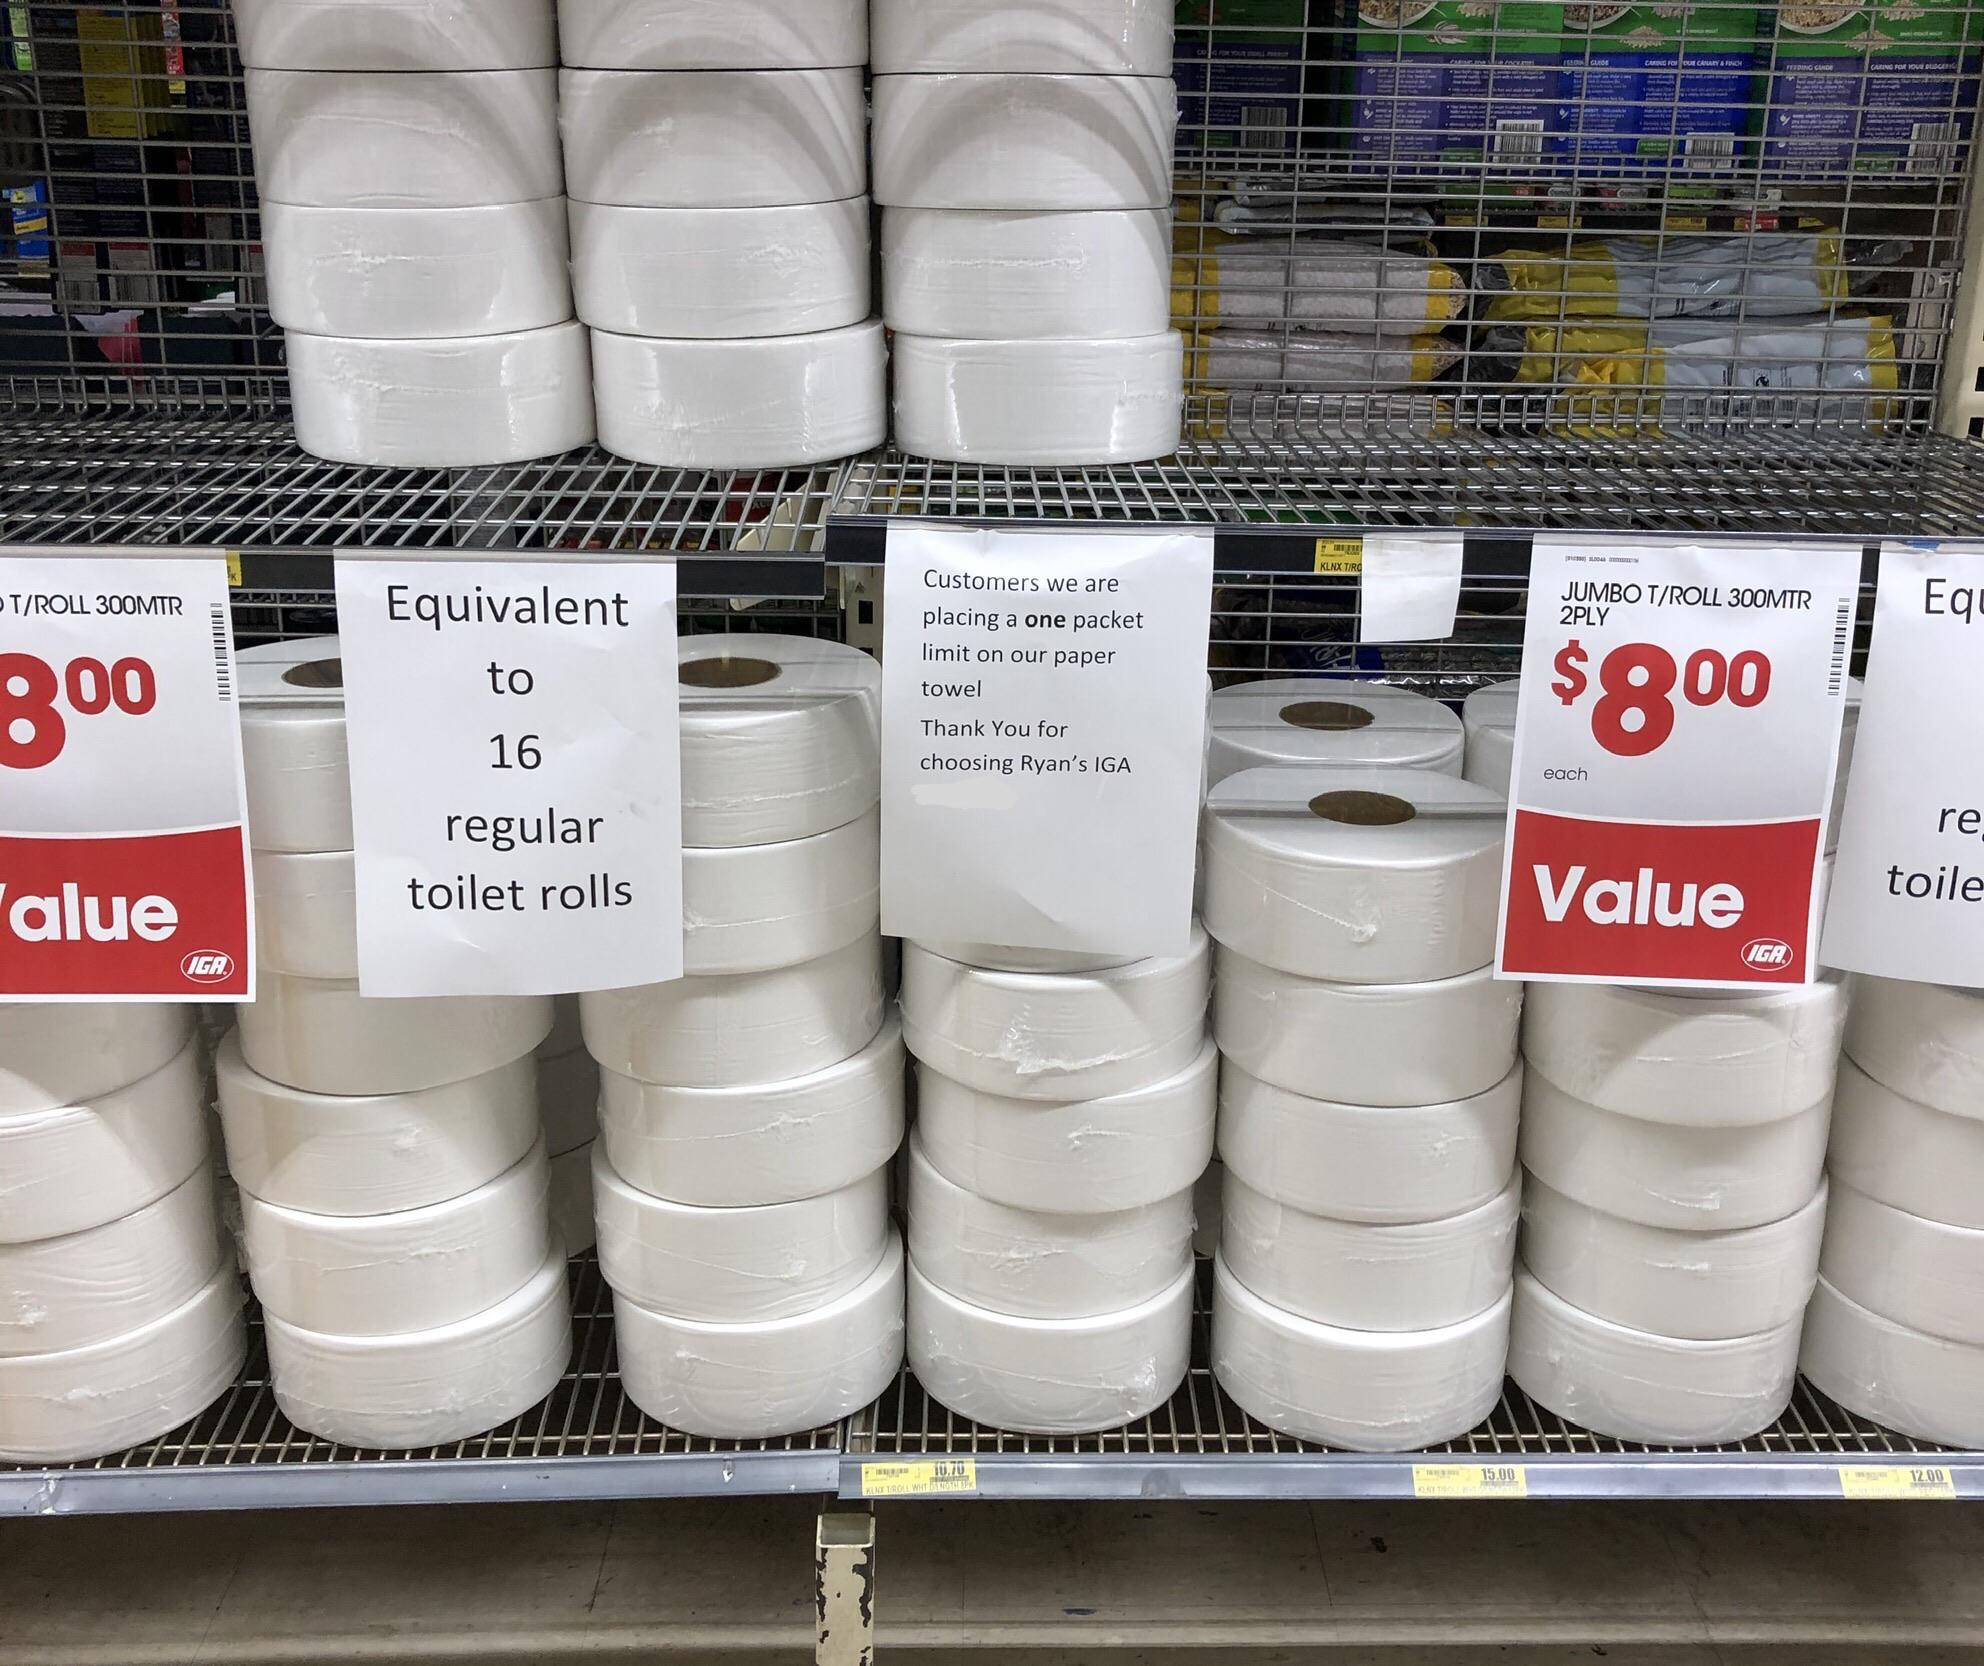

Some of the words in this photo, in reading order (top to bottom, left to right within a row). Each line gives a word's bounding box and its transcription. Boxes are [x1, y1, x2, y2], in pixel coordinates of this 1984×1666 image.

[1320, 561, 1342, 572] KLNX
[923, 569, 1040, 592] Customers
[1046, 578, 1078, 593] we
[1085, 578, 1119, 593] are
[9, 594, 91, 617] T/ROLL
[96, 594, 183, 616] 300MTR
[1560, 581, 1642, 604] JUMBO
[1647, 584, 1723, 609] T/ROLL
[1727, 588, 1812, 610] 300MTR
[387, 585, 629, 631] Equivalent
[923, 606, 1000, 632] placing
[1006, 613, 1017, 628] a
[1024, 614, 1066, 629] one
[1073, 609, 1144, 633] packet
[1559, 605, 1610, 627] 2PLY
[922, 642, 971, 662] limit
[977, 649, 1003, 663] on
[1011, 649, 1048, 664] our
[1054, 650, 1117, 669] paper
[486, 661, 534, 696] to
[921, 679, 982, 698] towel
[920, 718, 985, 737] Thank
[991, 720, 1031, 738] You
[1037, 719, 1069, 738] for
[490, 733, 542, 770] 16
[920, 752, 1014, 775] choosing
[1021, 754, 1088, 776] Ryan’s
[1095, 756, 1132, 774] IGA
[1543, 767, 1588, 781] each
[447, 807, 604, 852] regular
[1938, 808, 1984, 842] re
[407, 873, 525, 911] toilet
[541, 872, 633, 911] rolls
[1532, 864, 1745, 929] Value
[0, 882, 179, 942] alue
[187, 956, 228, 976] IGA
[1746, 944, 1787, 964] IGA
[934, 1461, 965, 1476] 10.70
[1480, 1467, 1516, 1481] 15.00
[1909, 1469, 1945, 1483] 12.00
